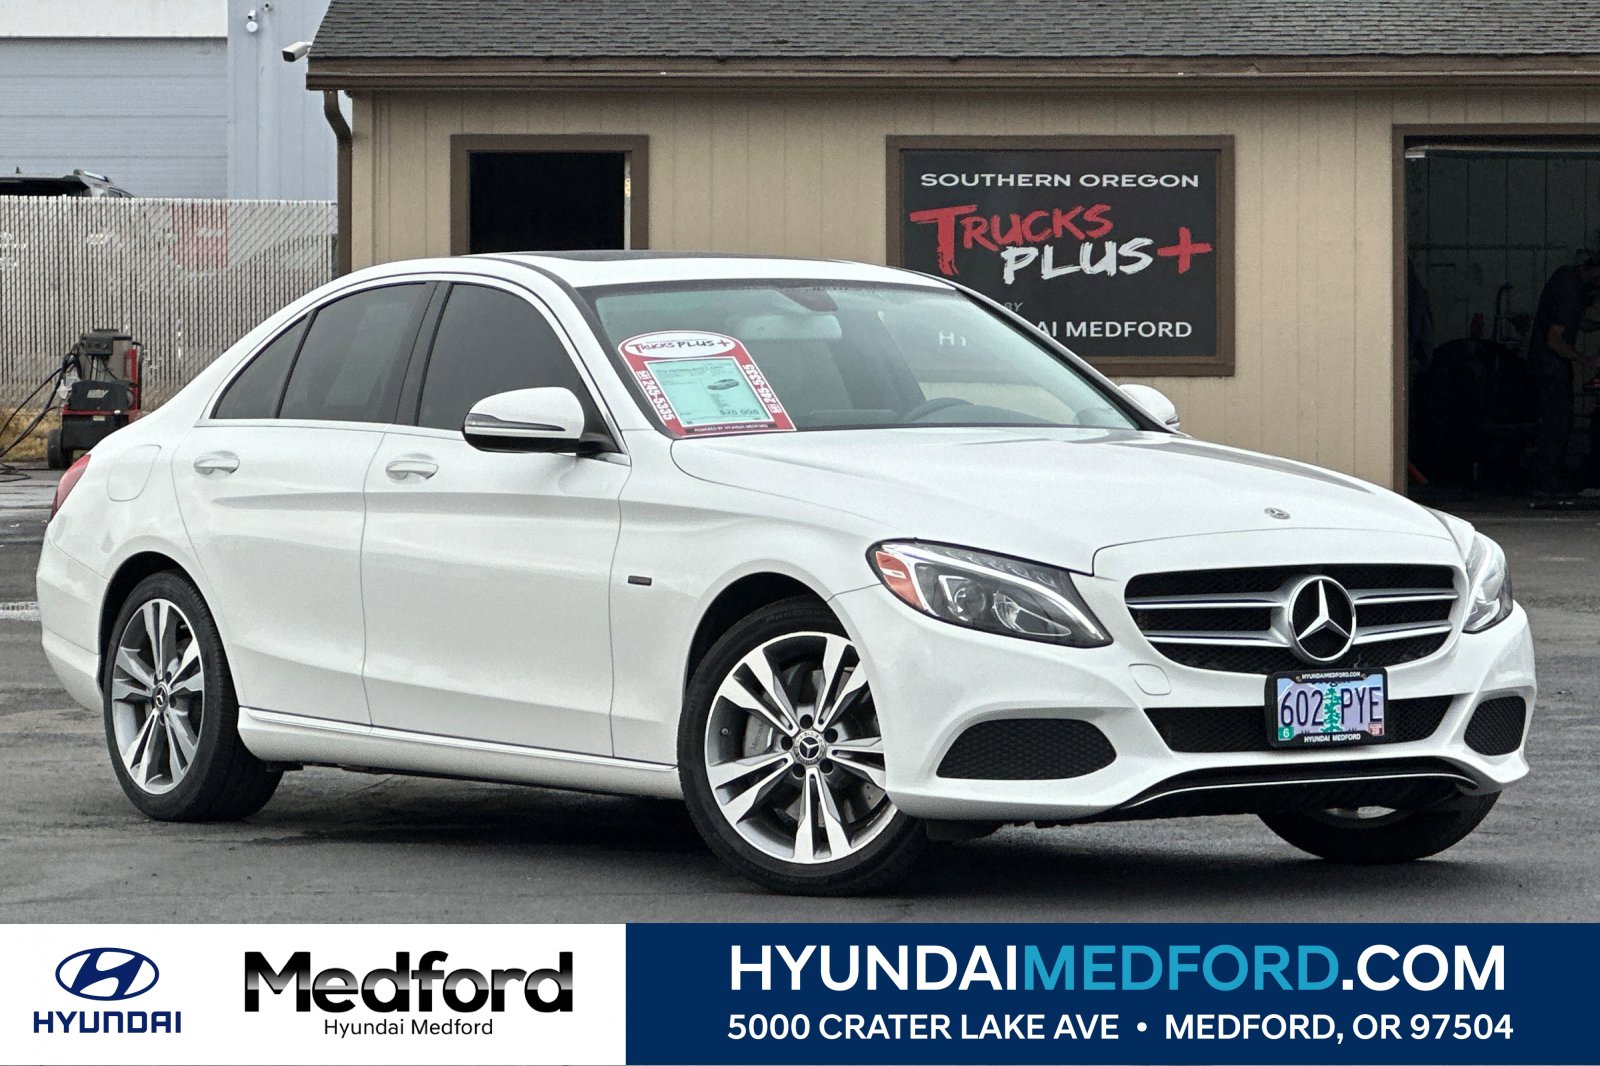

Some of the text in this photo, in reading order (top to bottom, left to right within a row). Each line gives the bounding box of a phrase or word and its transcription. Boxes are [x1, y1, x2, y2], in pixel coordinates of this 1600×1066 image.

[920, 173, 1199, 188] SOUTHERN OREGON
[909, 204, 1114, 275] TRUCKS
[1066, 321, 1193, 339] MEDFORD
[628, 342, 676, 354] TRUCKS
[642, 379, 675, 421] 245-5335
[1301, 671, 1361, 680] HYUNDAIMEDFORD.COM
[1280, 686, 1383, 728] 602 PYE
[1282, 728, 1290, 739] 6
[1304, 733, 1361, 743] HYUNDAI MEDFORD
